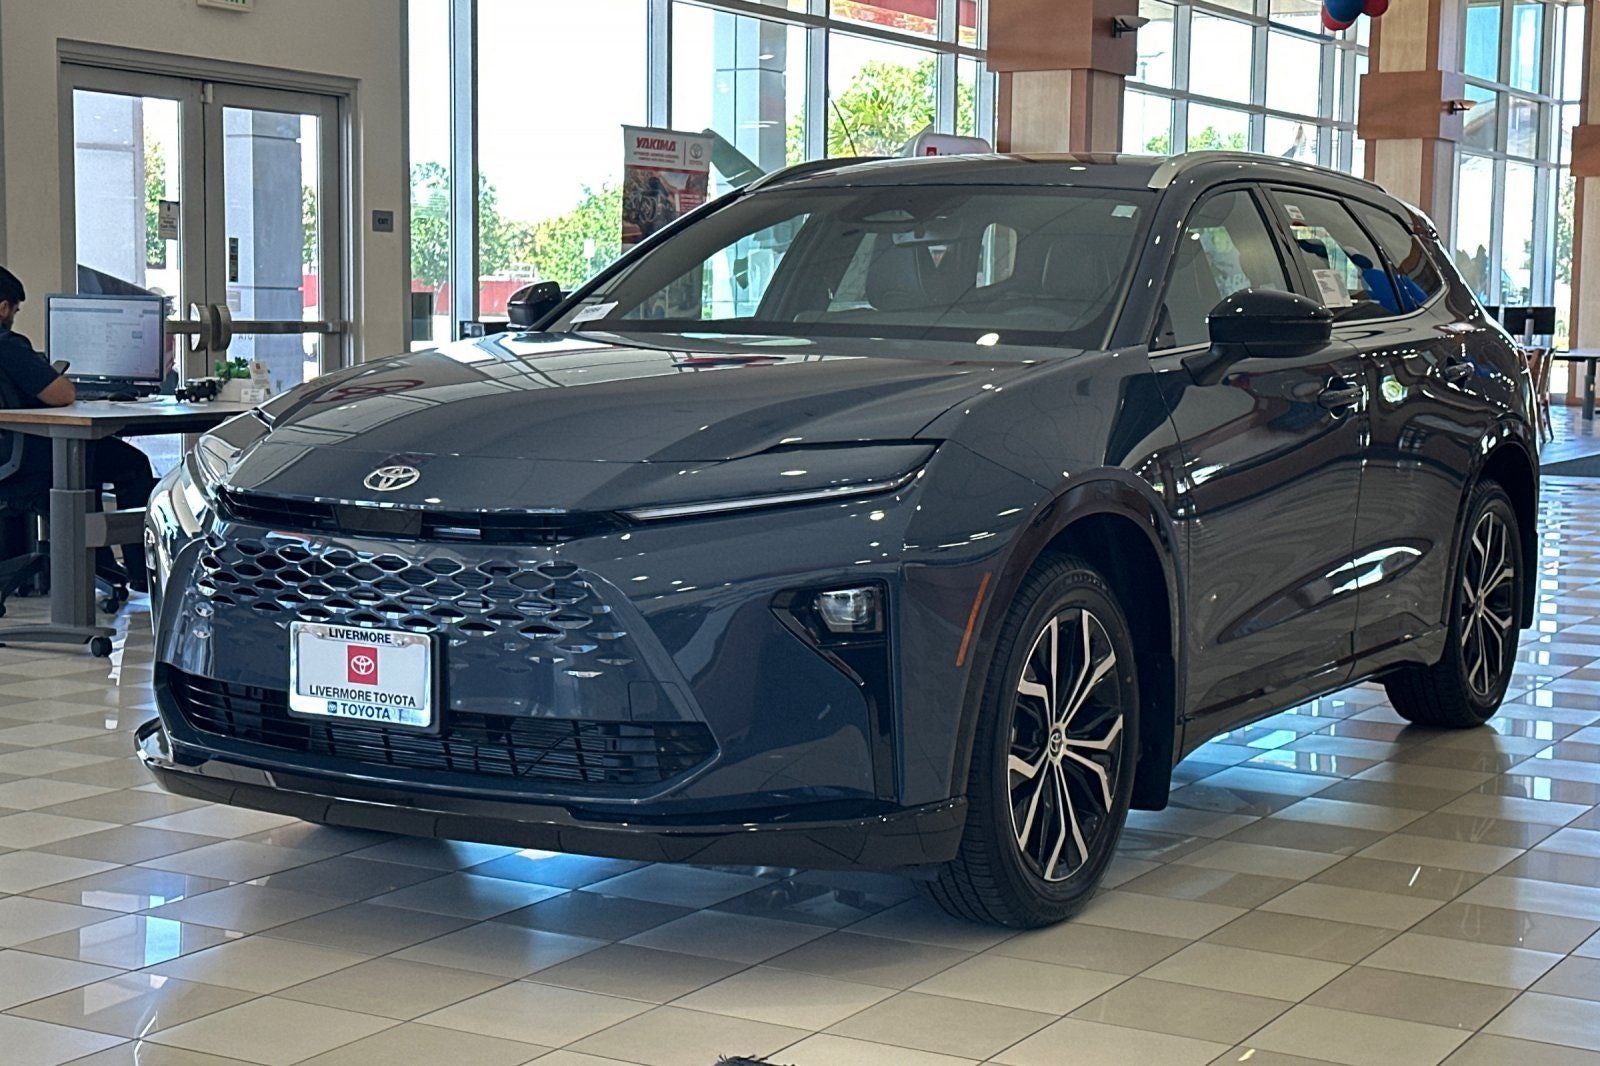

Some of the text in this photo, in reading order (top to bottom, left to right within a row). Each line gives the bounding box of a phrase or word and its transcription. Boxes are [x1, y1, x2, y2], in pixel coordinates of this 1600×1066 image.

[636, 137, 676, 152] YAKIMA
[328, 627, 392, 644] LIVERMORE
[309, 685, 416, 707] LIVERMORE TOYOTA
[341, 702, 391, 720] TOYOTA
